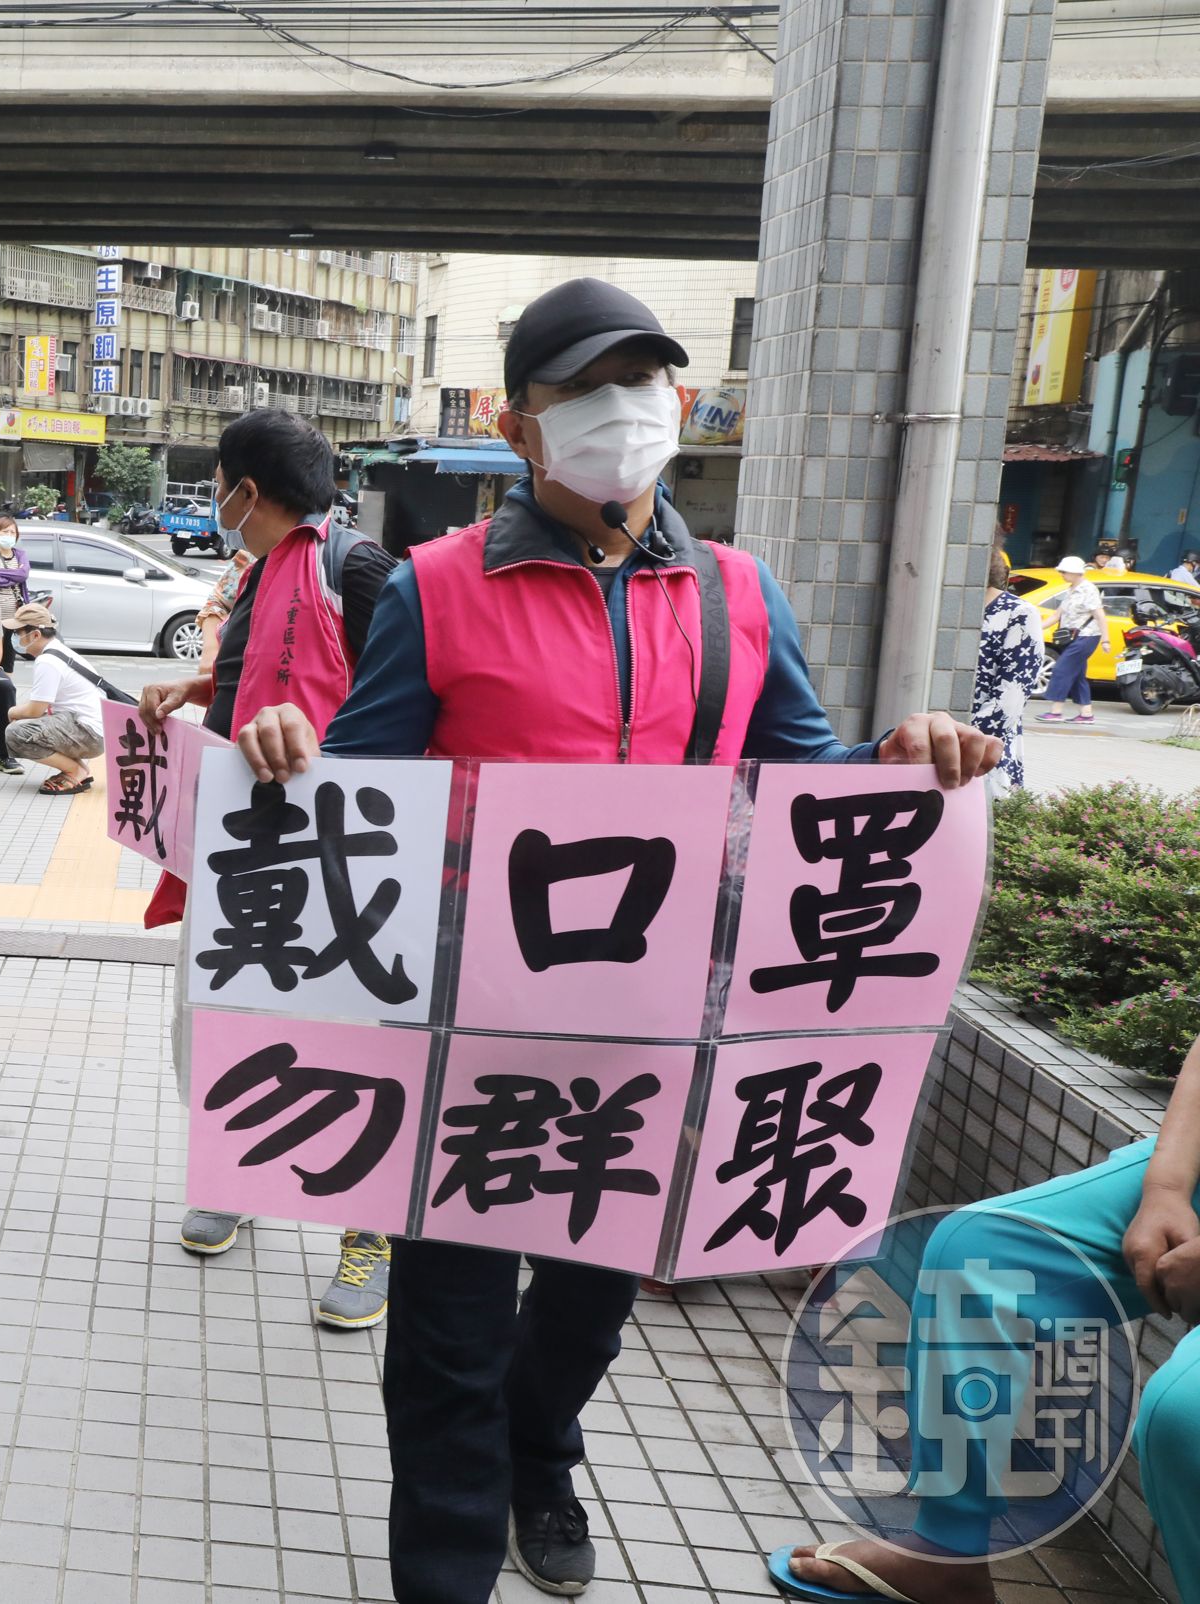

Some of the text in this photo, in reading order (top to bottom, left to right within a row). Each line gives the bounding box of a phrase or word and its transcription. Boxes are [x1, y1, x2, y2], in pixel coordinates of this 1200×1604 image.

[93, 267, 117, 392] 生原鋼珠
[274, 587, 302, 687] 三重區公所
[114, 717, 169, 860] 戴
[196, 780, 944, 1013] 戴口罩
[203, 1042, 883, 1257] 勿群聚
